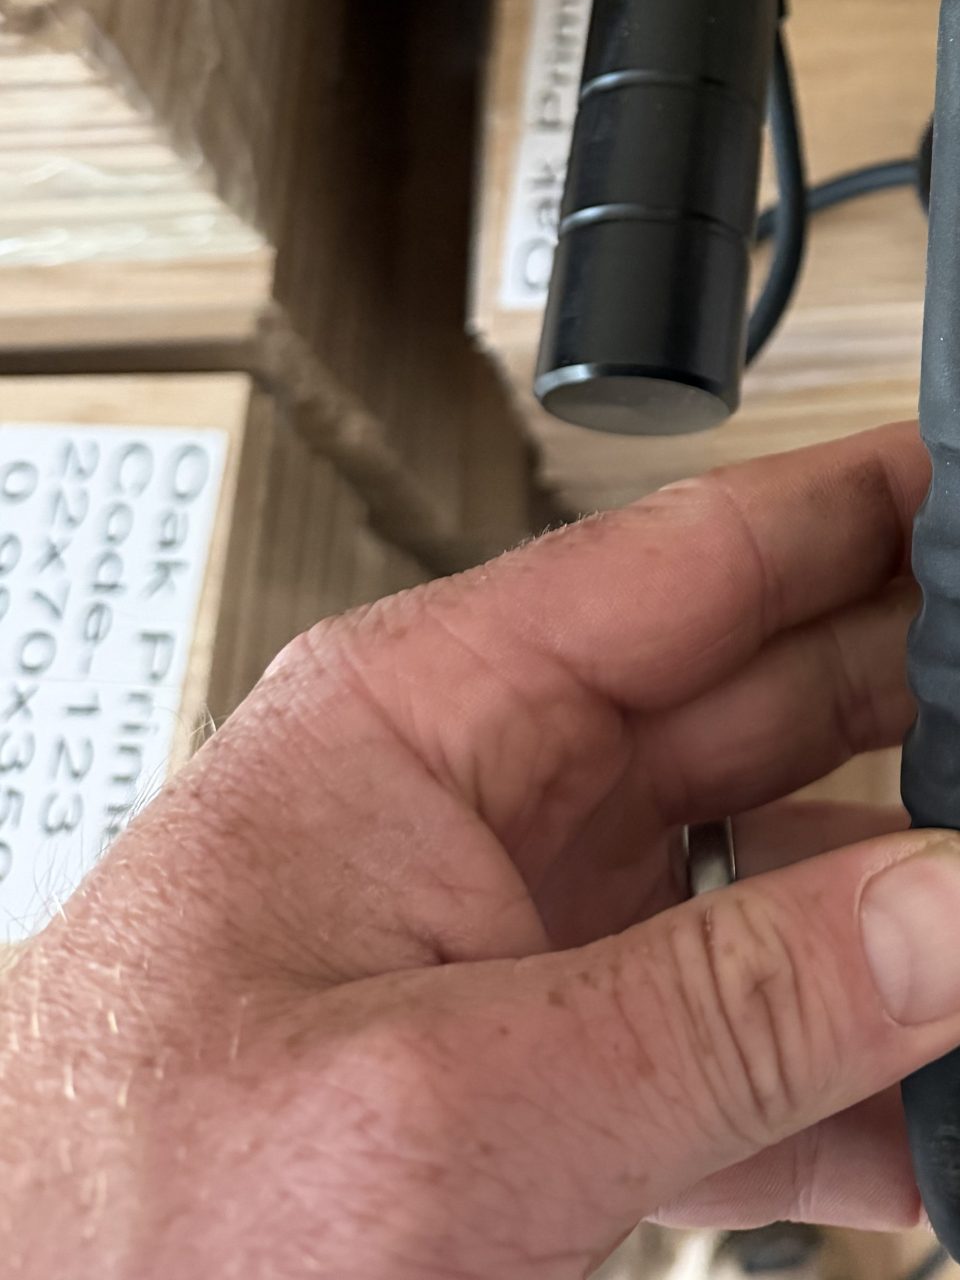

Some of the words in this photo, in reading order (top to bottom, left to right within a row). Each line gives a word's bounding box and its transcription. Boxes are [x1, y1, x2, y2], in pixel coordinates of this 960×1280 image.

[147, 441, 211, 600] Oak
[38, 441, 155, 837] Code-123
[102, 628, 176, 836] Prim
